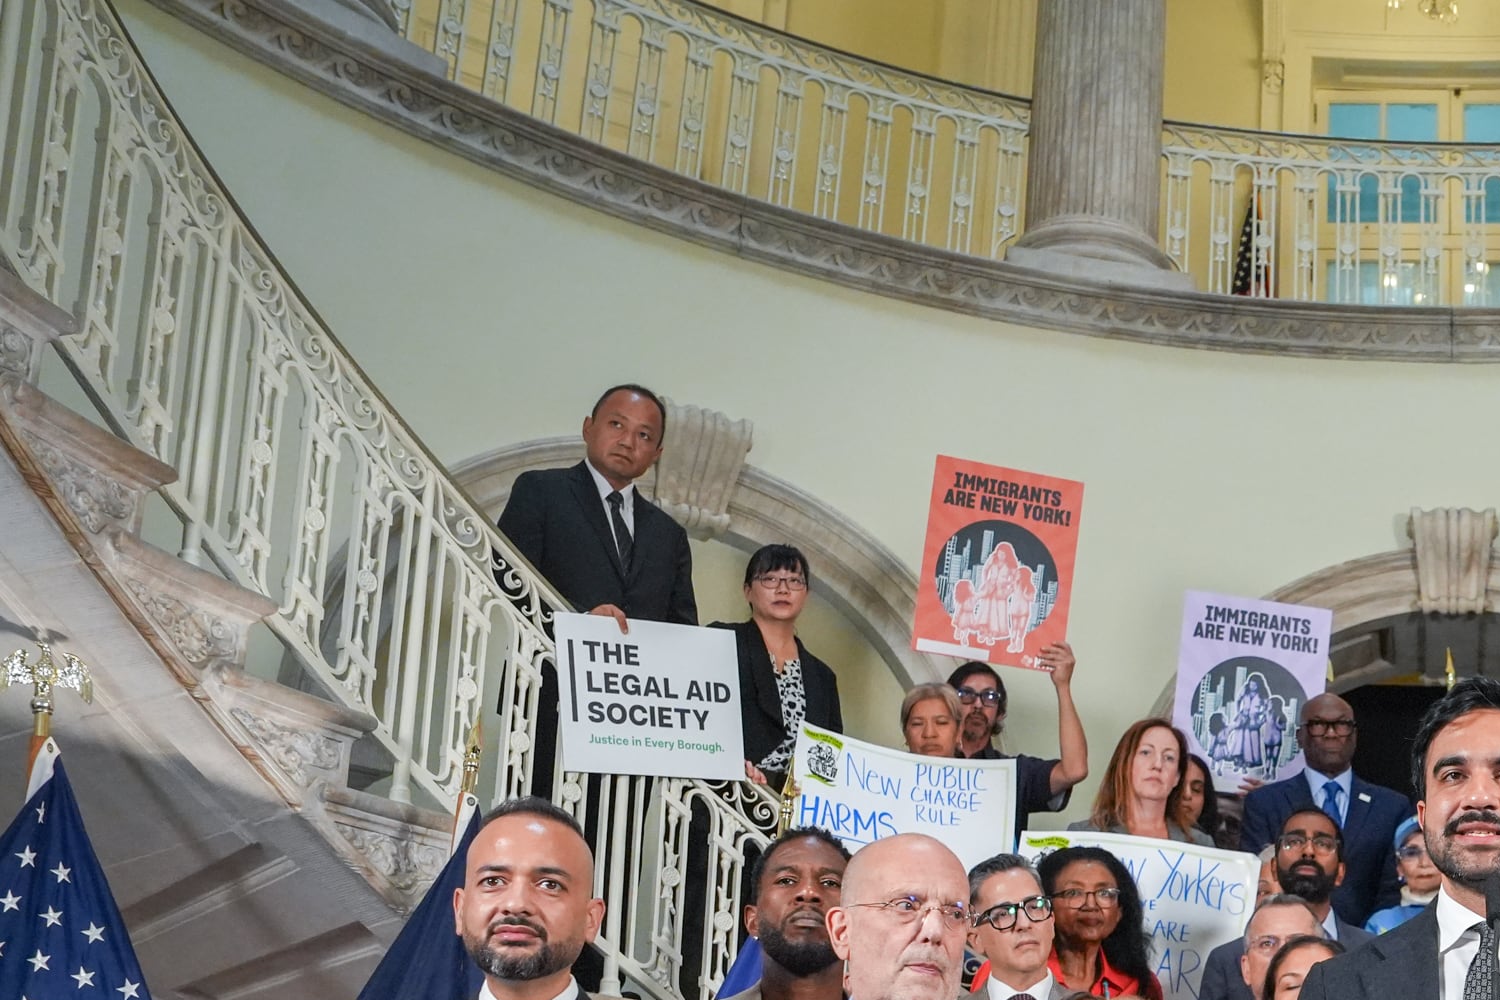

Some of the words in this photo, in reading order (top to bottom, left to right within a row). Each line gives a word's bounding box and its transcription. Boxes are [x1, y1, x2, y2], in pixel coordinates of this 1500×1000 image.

[953, 472, 1062, 507] IMMIGRANTS
[943, 489, 976, 509] ARE
[980, 495, 1019, 517] NEW
[1023, 502, 1072, 527] YORK!
[1205, 605, 1311, 635] IMMIGRANTS
[1193, 621, 1225, 640] ARE
[1229, 626, 1266, 647] NEW
[1271, 632, 1319, 654] YORK!
[582, 640, 640, 666] THE
[586, 670, 679, 699] LEGAL
[686, 680, 731, 703] AID
[587, 701, 710, 731] SOCIETY
[589, 734, 629, 746] Justice
[632, 736, 642, 746] in
[645, 737, 675, 751] Every
[678, 740, 725, 753] Borough.
[846, 752, 901, 799] New
[915, 763, 987, 791] PUBLIC
[910, 786, 982, 812] CHARGE
[800, 794, 898, 840] HARMS
[915, 804, 960, 826] RULE
[1156, 849, 1246, 915] Yorkers
[1146, 917, 1191, 943] ARE
